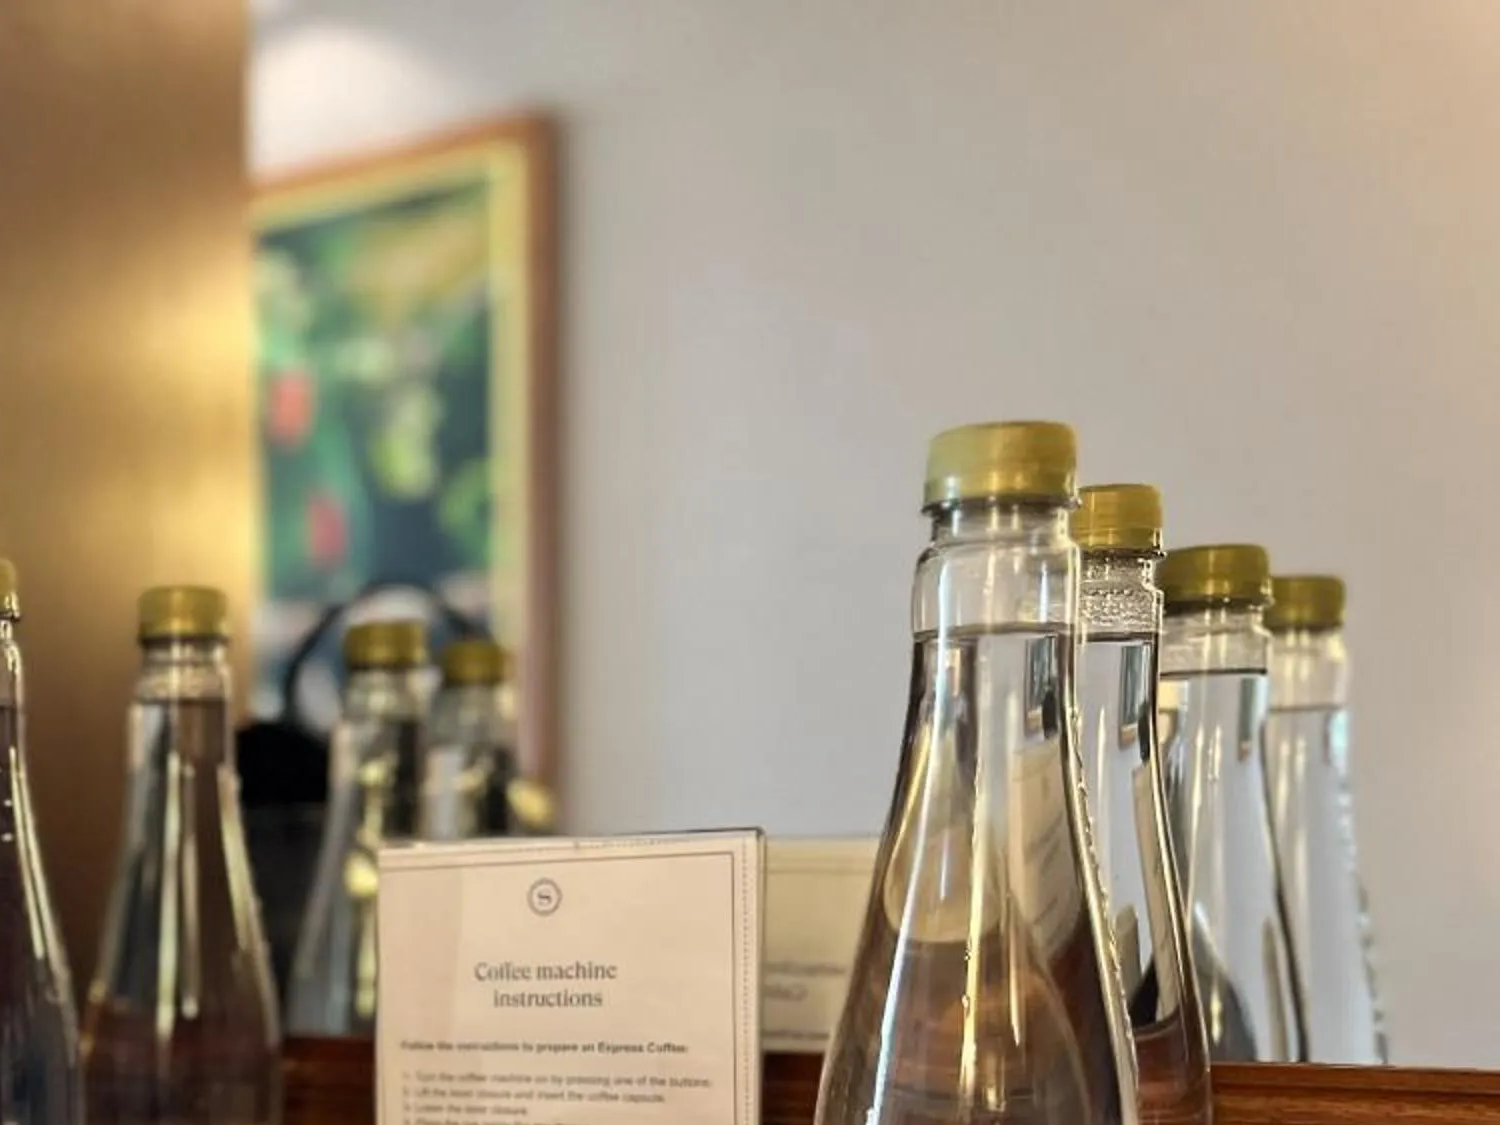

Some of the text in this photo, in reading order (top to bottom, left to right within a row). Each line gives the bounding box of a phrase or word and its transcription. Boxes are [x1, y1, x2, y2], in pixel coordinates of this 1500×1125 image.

[473, 960, 618, 982] Coffee machine
[492, 987, 603, 1008] instructions
[598, 1042, 644, 1055] Express
